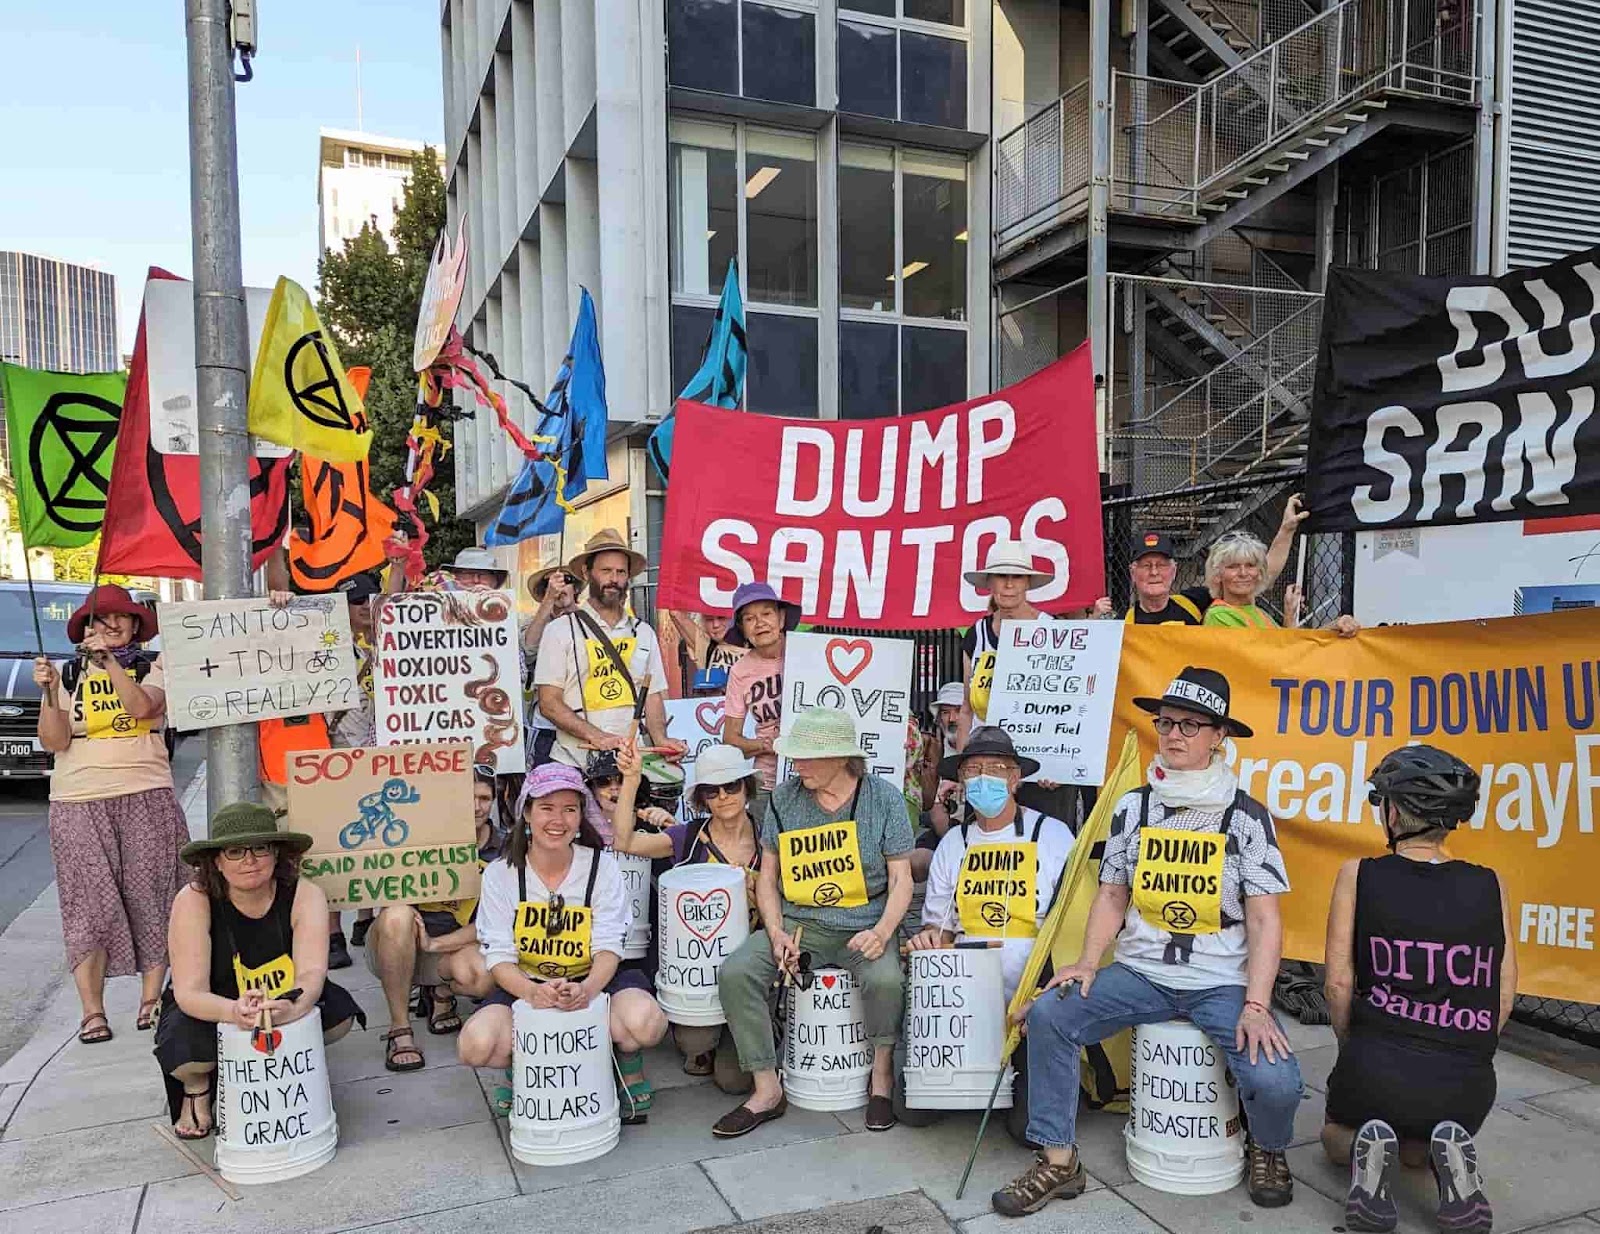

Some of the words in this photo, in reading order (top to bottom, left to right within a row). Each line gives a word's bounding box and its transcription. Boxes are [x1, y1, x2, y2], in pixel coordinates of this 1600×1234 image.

[775, 400, 1016, 518] DUMP
[1351, 385, 1595, 523] SAN
[699, 497, 1070, 620] SANTOS
[182, 608, 309, 640] SANTOS
[382, 602, 438, 625] STOP
[383, 627, 508, 651] ADVERTISING
[1013, 627, 1089, 650] LOVE
[229, 645, 294, 677] TDU
[383, 655, 472, 678] NOXIOUS
[1026, 653, 1076, 671] THE
[225, 678, 352, 717] REALLY??
[385, 684, 448, 706] TOXIC
[792, 681, 905, 723] LOVE
[1271, 678, 1394, 737] TOUR
[1410, 665, 1548, 735] DOWN
[1563, 660, 1600, 730] U
[386, 709, 476, 733] OIL/GAS
[1024, 703, 1072, 716] DUMP
[998, 718, 1042, 734] Fossil
[1055, 721, 1081, 735] Fuel
[372, 750, 467, 777] PLEASE
[1011, 743, 1082, 759] ponsorship
[790, 830, 848, 857] DUMP
[1146, 838, 1218, 864] DUMP
[363, 853, 395, 869] NO
[401, 844, 478, 867] CYCLIST
[791, 854, 855, 882] SANTOS
[967, 850, 1025, 872] DUMP
[963, 879, 1027, 897] SANTOS
[1141, 871, 1218, 895] SANTOS
[683, 903, 726, 921] BIKES
[1519, 903, 1594, 950] FREE
[520, 937, 583, 958] SANTOS
[677, 936, 728, 960] LOVE
[914, 954, 973, 979] FOSSIL
[1370, 935, 1494, 988] DITCH
[813, 992, 851, 1010] RACE
[913, 985, 965, 1009] FUELS
[1367, 983, 1493, 1031] Santos
[798, 1023, 828, 1046] CUT
[913, 1014, 943, 1039] OUT
[949, 1014, 975, 1039] OF
[516, 1030, 538, 1055] NO
[544, 1025, 598, 1054] MORE
[224, 1060, 260, 1083] THE
[264, 1048, 315, 1081] RACE
[821, 1048, 874, 1071] SANTOS
[913, 1044, 965, 1068] SPORT
[1141, 1039, 1216, 1067] SANTOS
[526, 1064, 581, 1088] DIRTY
[1141, 1072, 1218, 1103] PEDDLES
[241, 1089, 270, 1114] ON
[277, 1083, 309, 1108] YA
[515, 1092, 600, 1121] DOLLARS
[244, 1112, 311, 1145] GRACE
[1141, 1107, 1219, 1138] DISASTER
